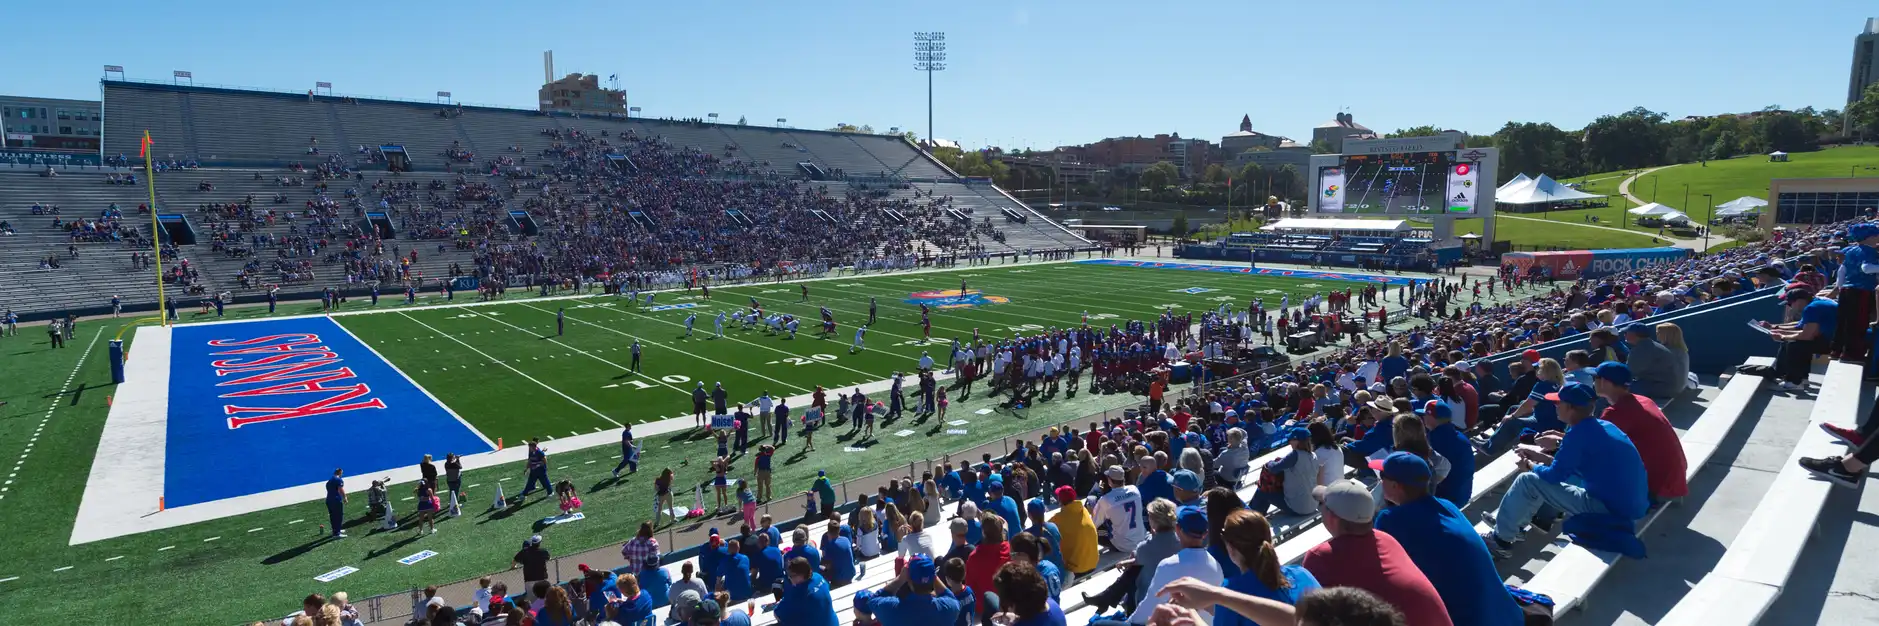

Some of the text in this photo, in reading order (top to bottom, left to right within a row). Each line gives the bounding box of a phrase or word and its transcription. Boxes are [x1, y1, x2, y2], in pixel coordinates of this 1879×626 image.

[1592, 258, 1632, 273] ROCK
[459, 279, 475, 289] KU
[783, 353, 838, 366] 20
[207, 333, 387, 430] KANSAS
[622, 374, 691, 390] 10
[711, 415, 734, 428] Noise!
[1123, 500, 1137, 530] 7
